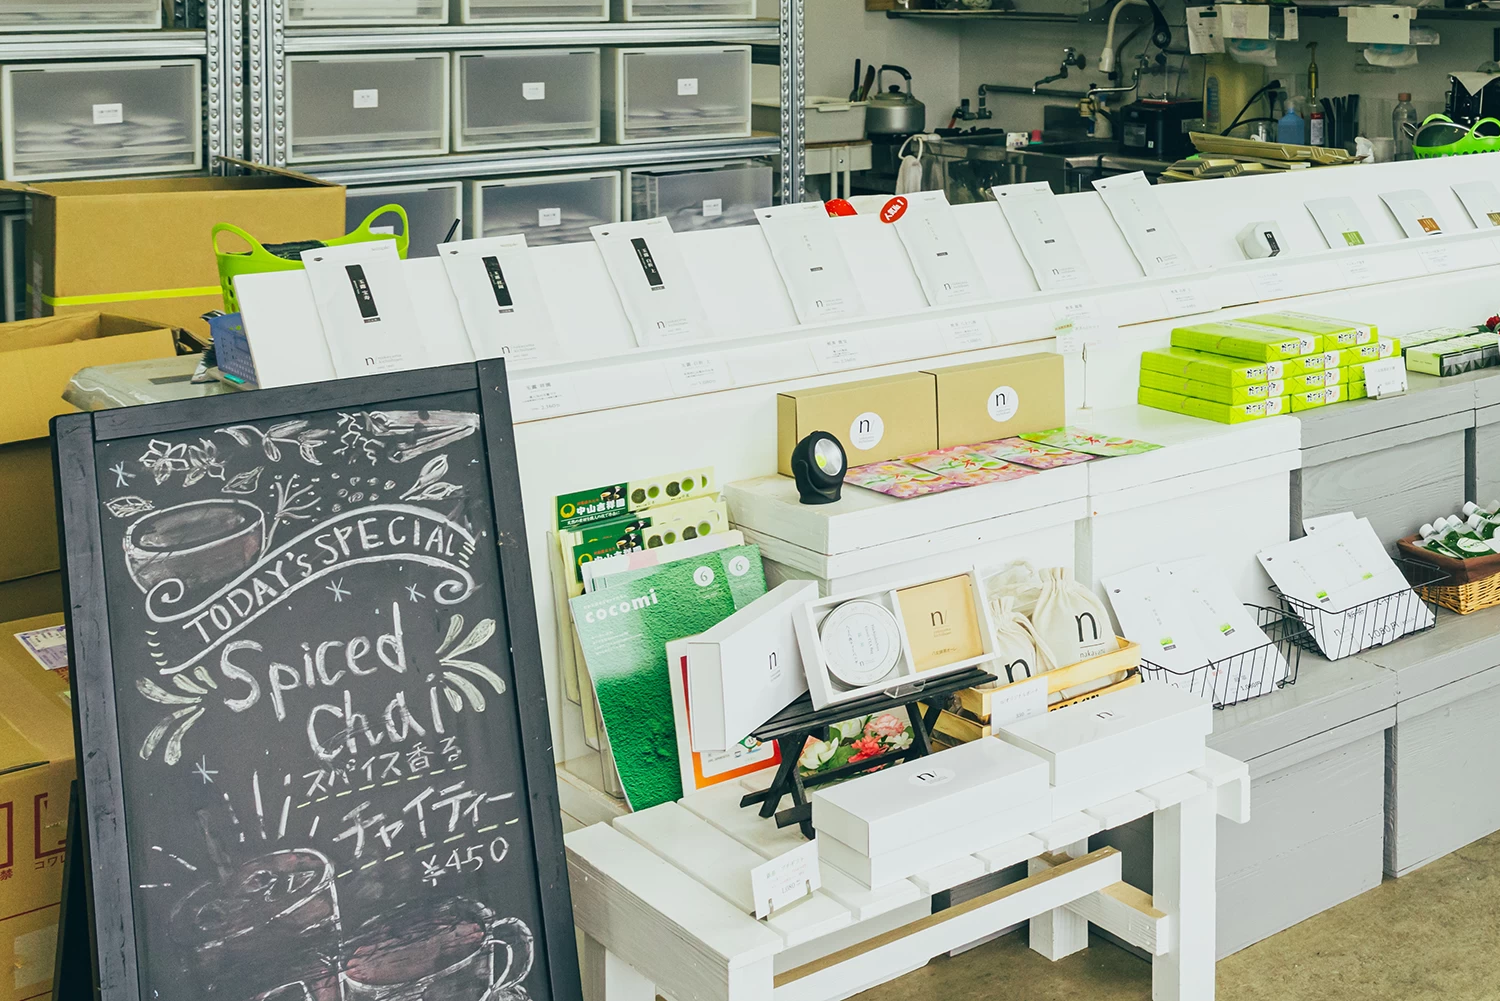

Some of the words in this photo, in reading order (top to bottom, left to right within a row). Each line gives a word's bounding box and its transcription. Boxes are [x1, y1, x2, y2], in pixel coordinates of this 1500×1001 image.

[576, 499, 626, 516] 中山吉祥園
[183, 550, 312, 645] TODAY'S
[316, 518, 460, 566] SPECIAL
[700, 572, 708, 582] 6
[735, 562, 744, 571] 6
[585, 588, 659, 624] cocomi
[219, 601, 409, 721] Spiced
[308, 678, 447, 762] Chai
[305, 735, 464, 795] スパイス香る
[333, 780, 515, 859] チャイティー
[422, 837, 510, 886] ¥450
